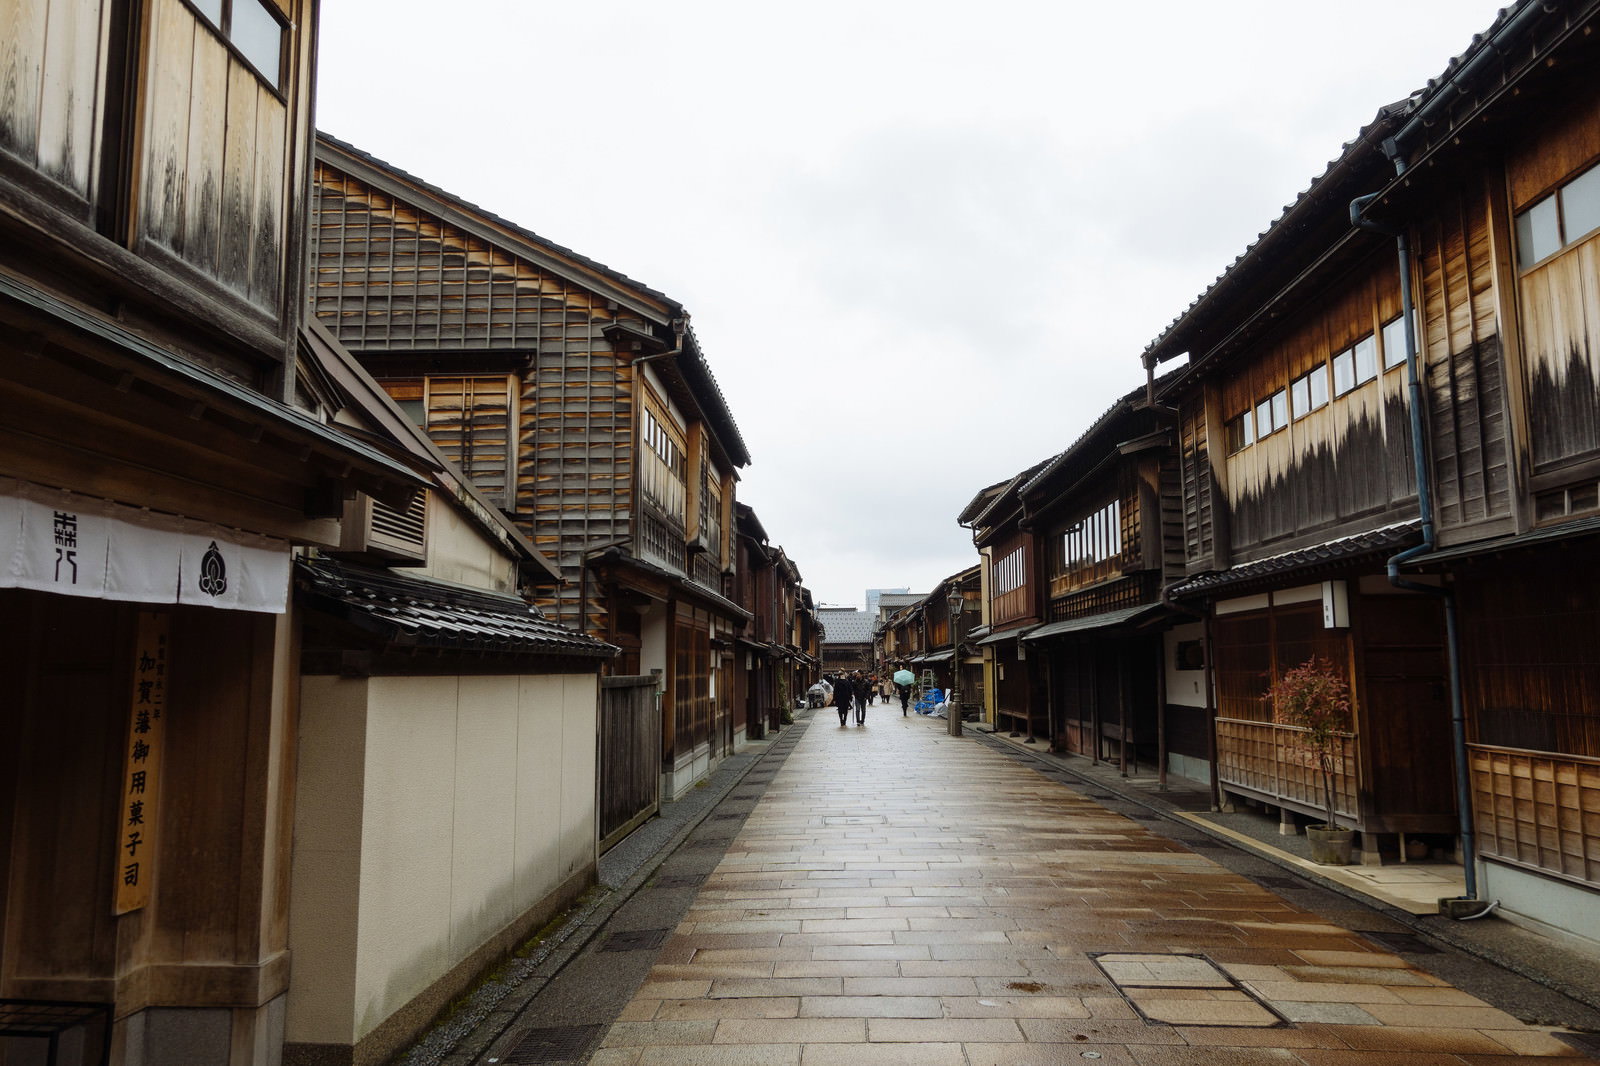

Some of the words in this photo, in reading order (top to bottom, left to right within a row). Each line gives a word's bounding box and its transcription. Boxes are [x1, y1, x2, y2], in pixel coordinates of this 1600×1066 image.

[124, 651, 156, 887] 加賀藩御用菓子司
